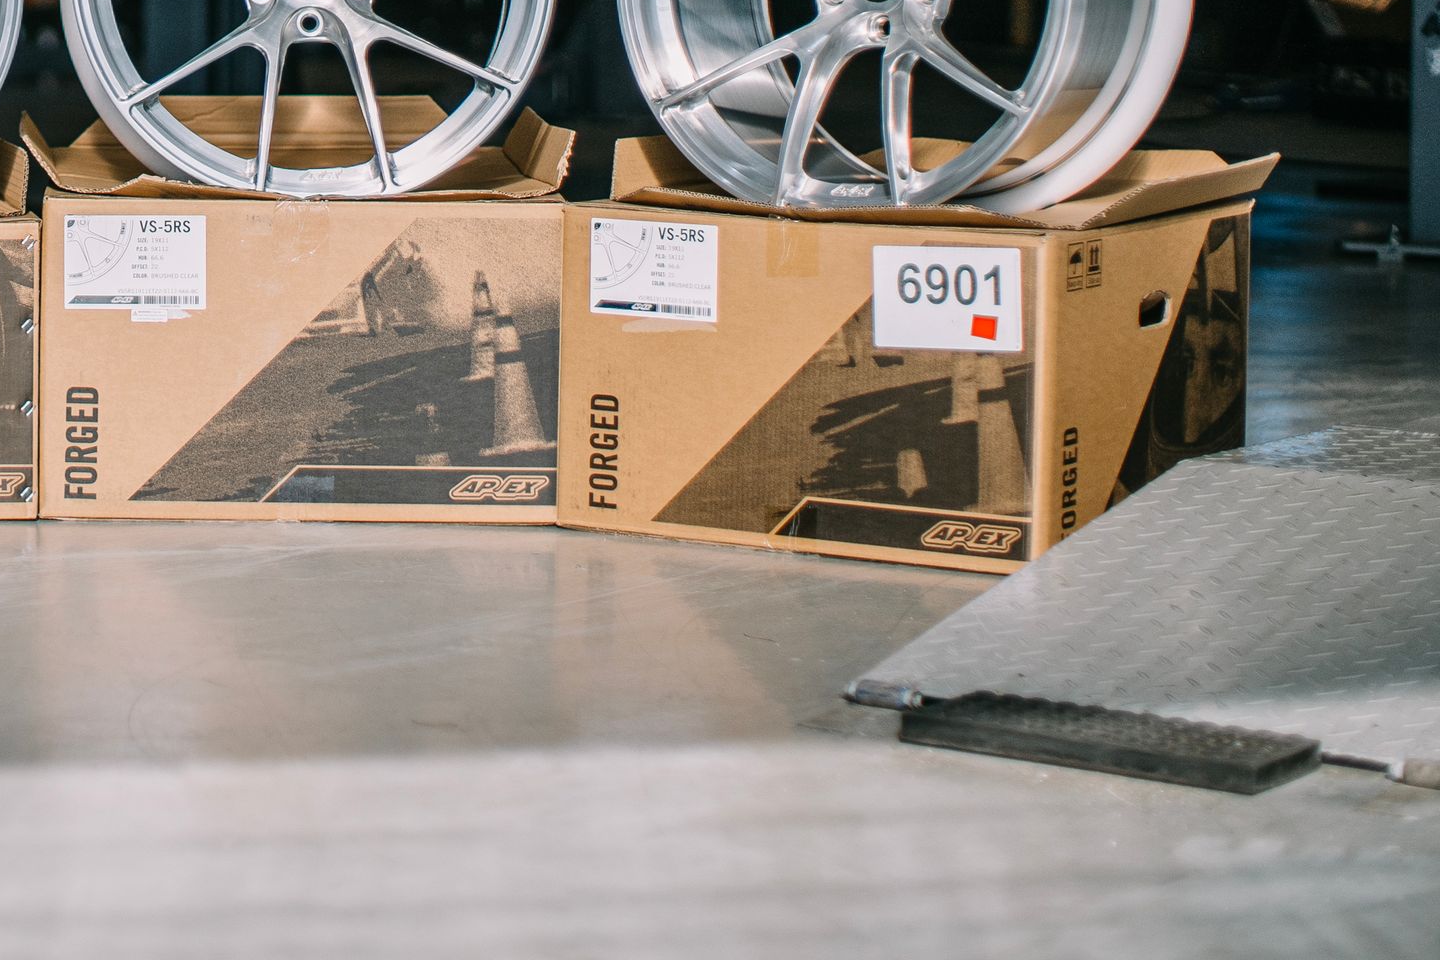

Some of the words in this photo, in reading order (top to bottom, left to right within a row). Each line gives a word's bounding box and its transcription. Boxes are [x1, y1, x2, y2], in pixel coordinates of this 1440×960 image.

[140, 220, 191, 233] VS-5RS
[658, 227, 705, 243] VS-5RS
[897, 263, 1001, 306] 6901
[64, 386, 99, 500] FORGED
[589, 393, 619, 510] FORGED
[453, 476, 547, 498] APEX
[1061, 427, 1079, 540] ORGED
[924, 522, 1019, 550] APEX
